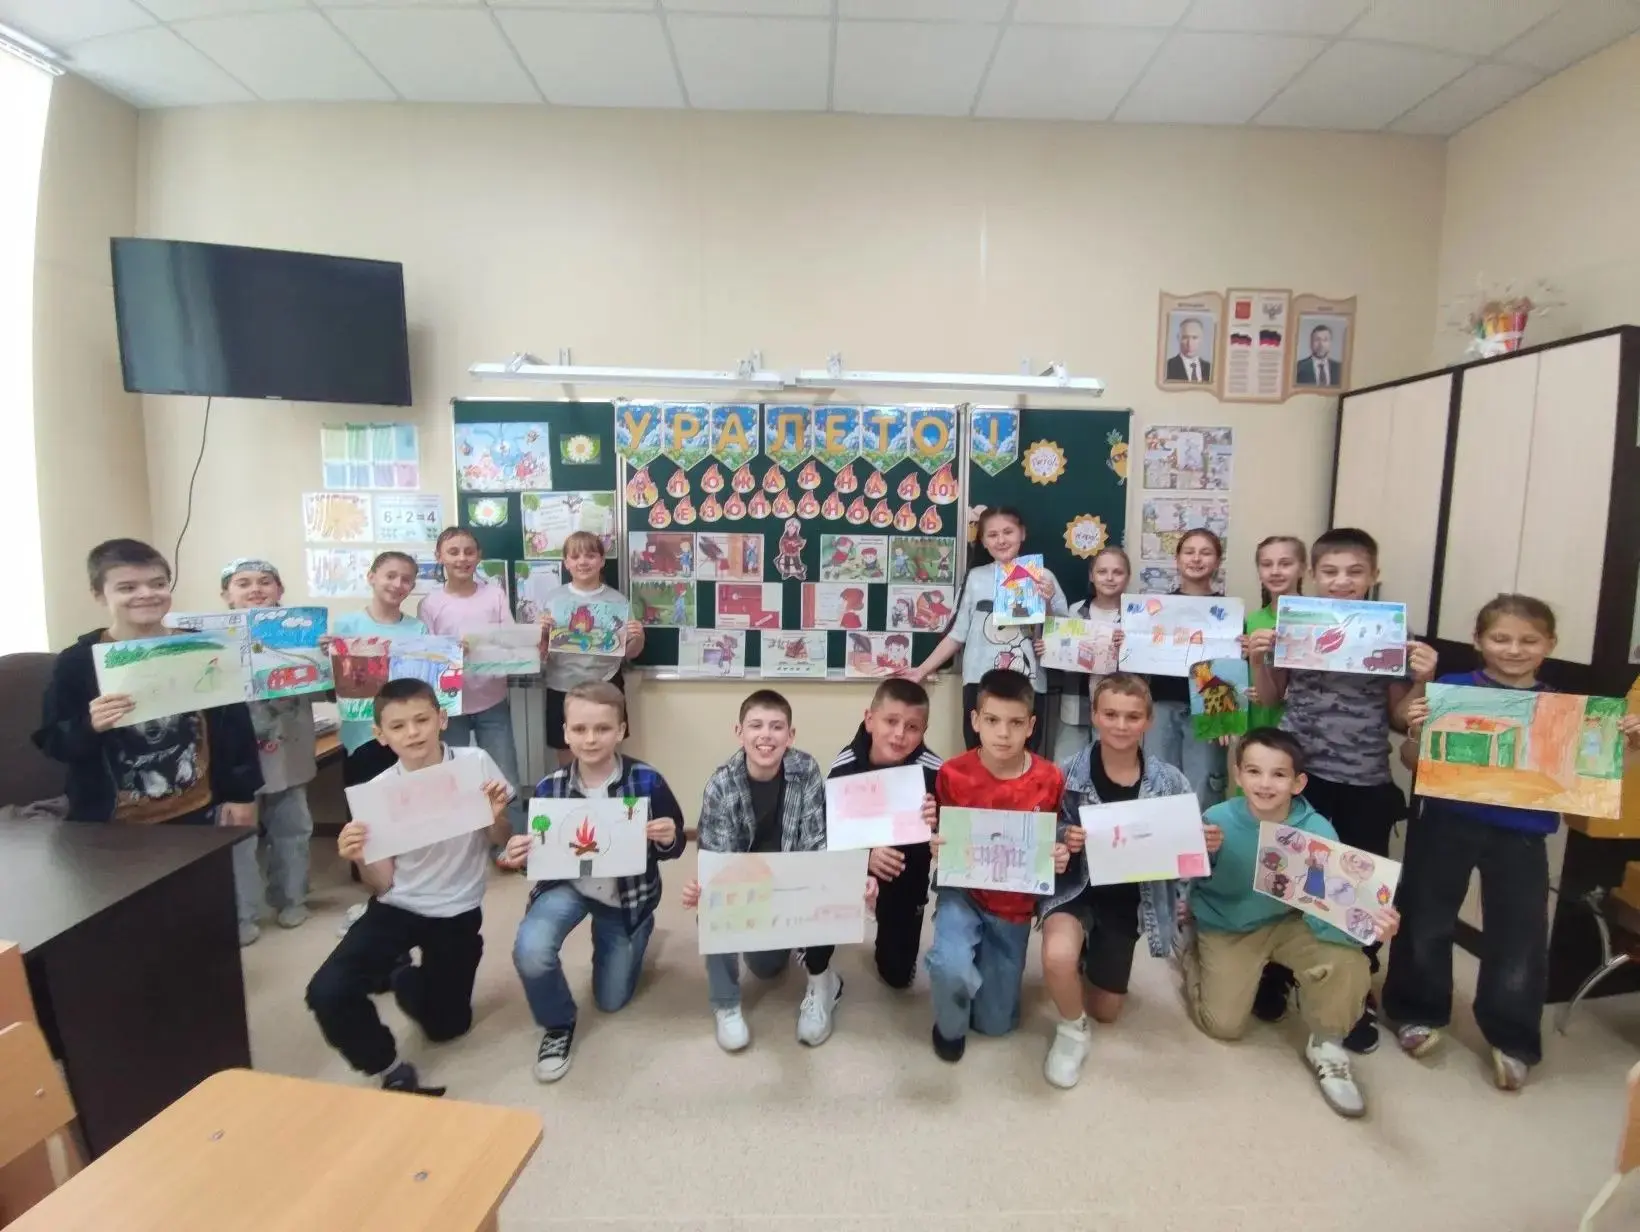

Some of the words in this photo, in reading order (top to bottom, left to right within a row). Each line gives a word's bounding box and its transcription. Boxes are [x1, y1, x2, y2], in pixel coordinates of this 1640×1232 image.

[668, 472, 916, 500] ПОЖАРНАЯ
[931, 481, 958, 497] 101
[653, 502, 937, 529] БЕЗОПАСНОСТЬ
